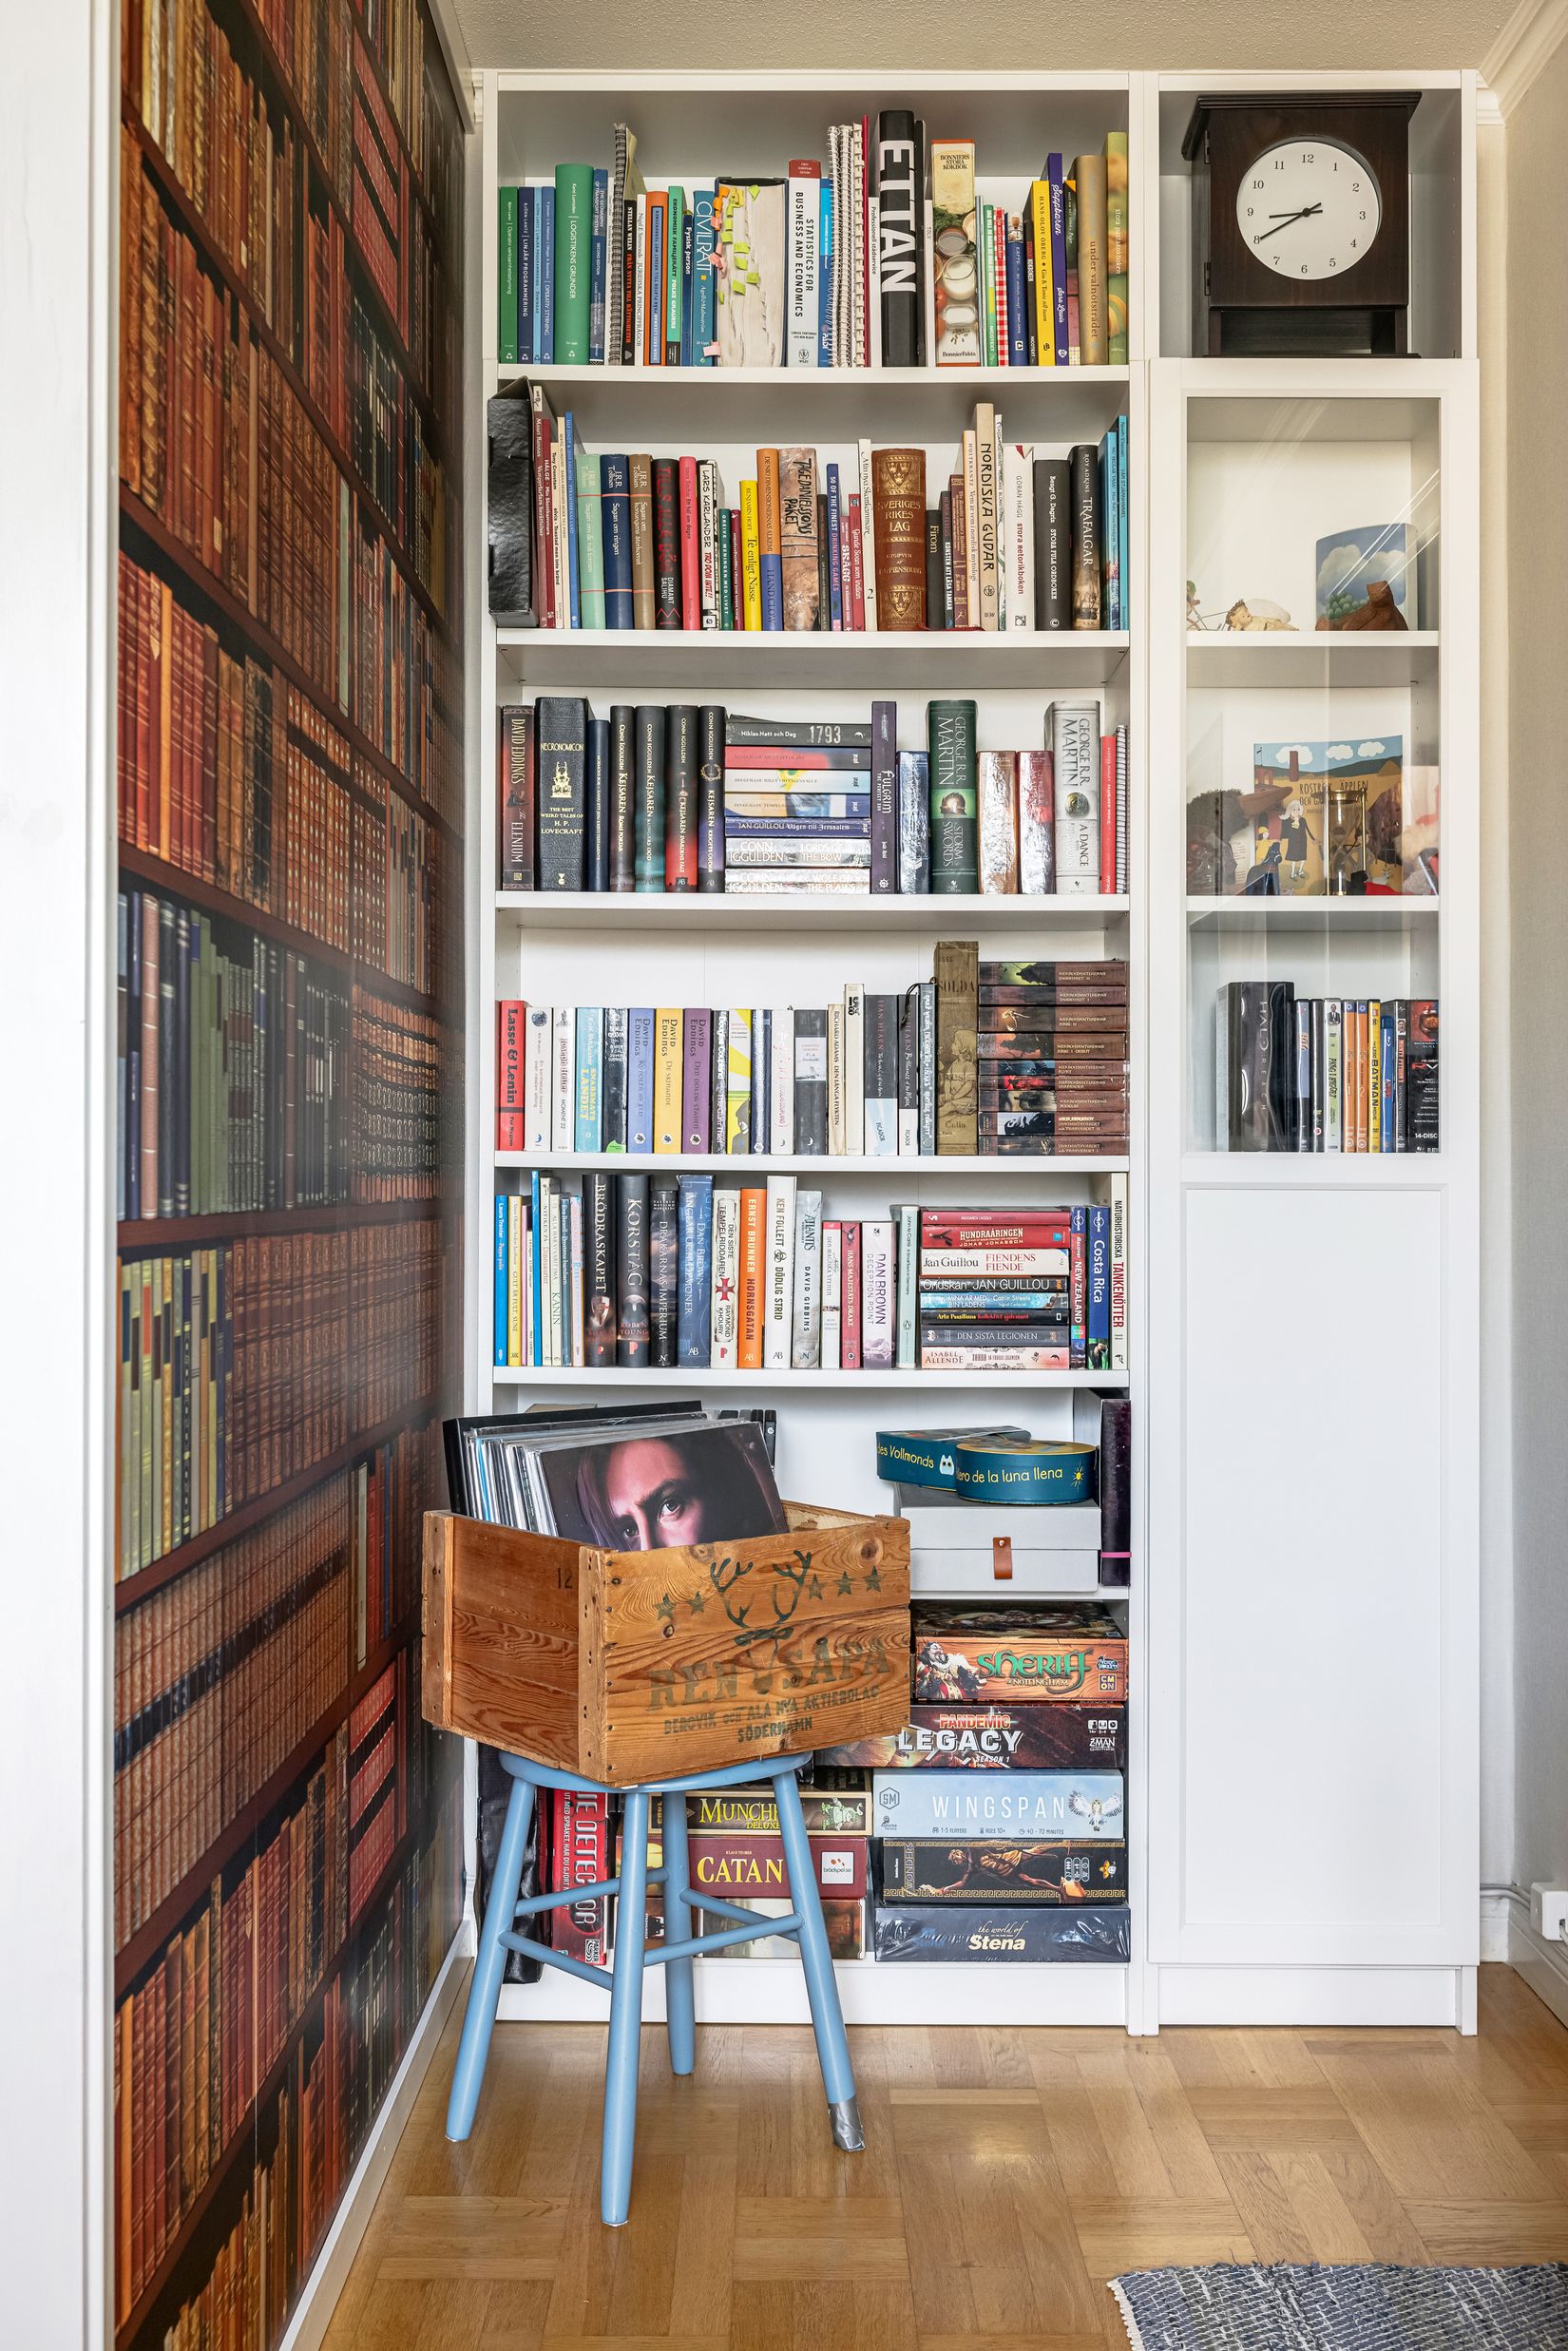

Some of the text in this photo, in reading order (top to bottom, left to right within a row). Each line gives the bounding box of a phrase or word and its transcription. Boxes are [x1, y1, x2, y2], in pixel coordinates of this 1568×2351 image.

[1274, 161, 1285, 170] 11
[1302, 154, 1314, 163] 12
[1333, 162, 1338, 171] 1
[1252, 180, 1264, 189] 10
[1352, 182, 1360, 192] 2
[880, 141, 915, 293] ETTAN
[1114, 209, 1122, 224] stora
[1247, 207, 1253, 217] 9
[1359, 211, 1366, 220] 3
[1253, 235, 1261, 244] 8
[1350, 239, 1357, 248] 4
[795, 192, 804, 317] BUSINESS AND ECONOMICS
[1090, 241, 1099, 272] under
[1273, 256, 1280, 265] 7
[1329, 258, 1336, 267] 5
[1301, 264, 1308, 274] 6
[830, 485, 837, 493] OF
[702, 469, 711, 547] LARS KARLANDER
[783, 499, 798, 526] PAKET
[981, 443, 994, 572] NORDISKA GUDAR
[613, 524, 620, 533] om
[641, 522, 647, 531] om
[889, 522, 910, 532] LAG
[1080, 497, 1093, 566] TRAFALGAR
[612, 535, 621, 555] ringen
[746, 550, 757, 602] enligt Nasse
[867, 588, 873, 600] 2
[810, 725, 841, 743] 1793
[954, 717, 966, 760] GEORGE
[1079, 718, 1090, 762] GEORGE
[938, 717, 954, 785] MARTIN
[1062, 718, 1078, 786] MARTIN
[511, 718, 526, 863] DAVID EDDINGS ELENIUM
[619, 773, 627, 812] KEJSAREN
[646, 775, 655, 816] KEJSAREN
[882, 771, 894, 813] FULGRIM
[730, 851, 784, 861] IGGULDEN
[943, 821, 953, 867] SWORDS
[954, 826, 963, 859] STORM
[1079, 824, 1089, 867] A DANCE
[670, 1019, 679, 1047] DAVID
[1259, 1002, 1268, 1051] HALO
[507, 1008, 519, 1103] Lasse & Lenin
[595, 1184, 607, 1292] BRÖDRASKAPET
[627, 1198, 643, 1286] KORSTÅG
[804, 1214, 816, 1251] ATLANTIS
[960, 1228, 1023, 1241] HUNDRAÅRINGEN
[697, 1223, 705, 1285] DAN BROWN
[774, 1198, 785, 1320] KEN FOLLETT DÖDLIG STRID
[923, 1257, 979, 1267] Jan Guillou
[1113, 1200, 1125, 1328] NATURHISTORISKA TANKENÖTTER
[659, 1221, 667, 1340] DRAKARNAS IMPERIUM
[745, 1199, 755, 1341] ERNST BRUNNER HORNSGATAN
[1093, 1240, 1105, 1303] Costa Rica
[875, 1253, 886, 1325] DAN BROWN
[972, 1279, 1050, 1290] JAN GUILLOU
[1074, 1261, 1082, 1323] NEW ZEALAND
[889, 1444, 934, 1469] Vollmonds
[972, 1466, 1063, 1482] de la luna llena
[939, 1713, 1011, 1730] PANDEMIC
[898, 1730, 1023, 1753] LEGACY
[931, 1796, 1064, 1819] WINGSPAN
[697, 1856, 784, 1883] CATAN
[968, 1934, 1026, 1950] Stena
